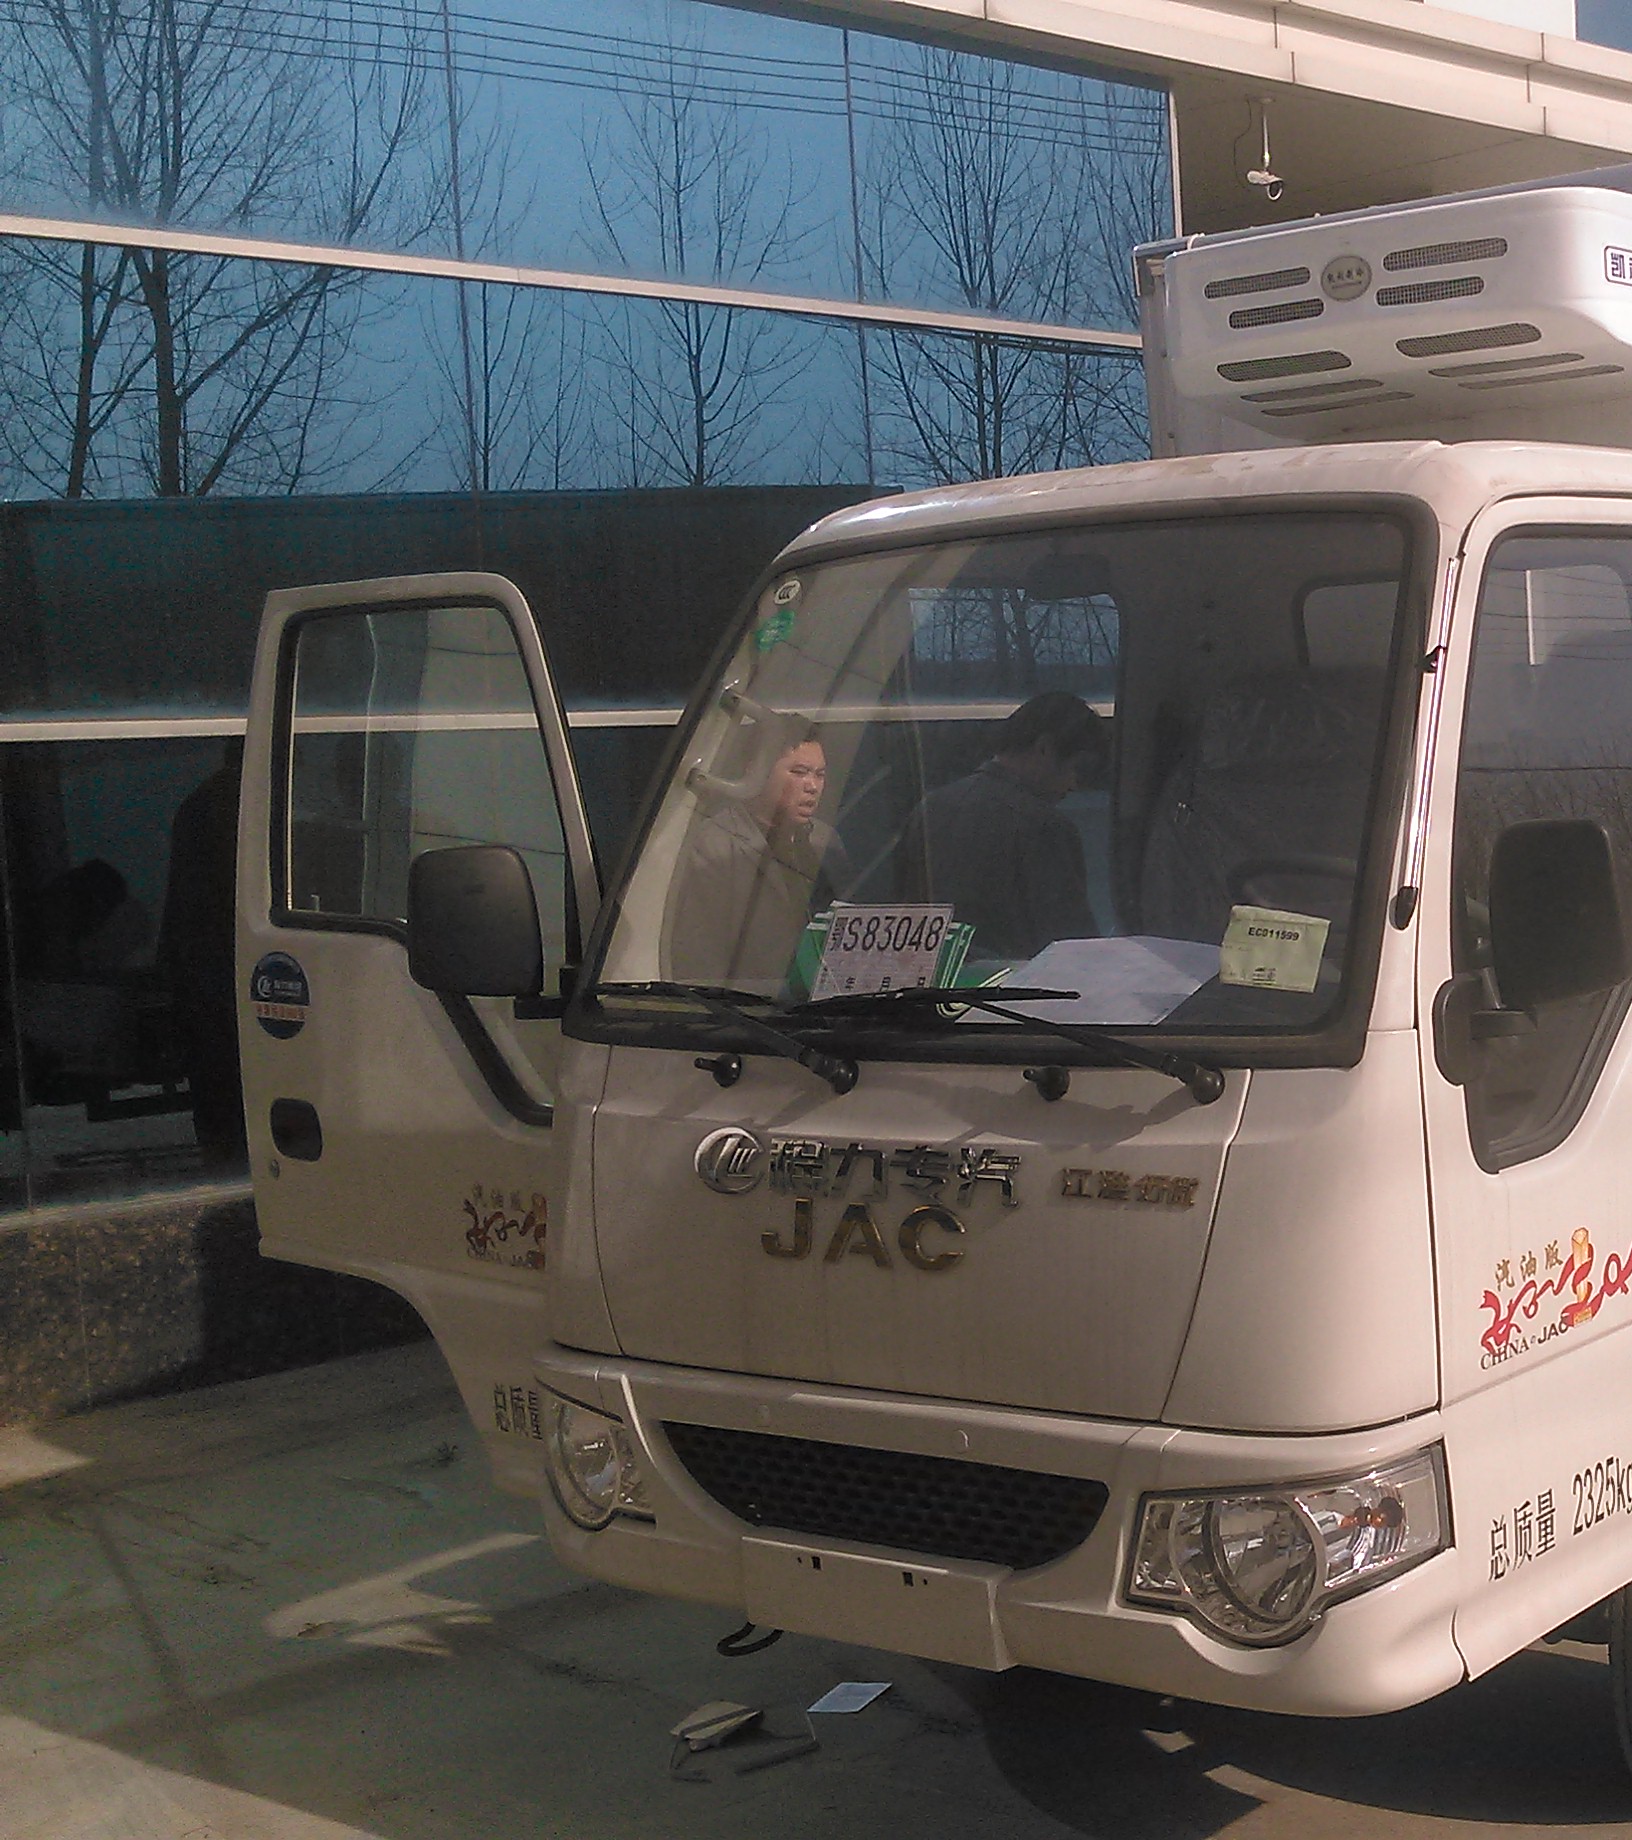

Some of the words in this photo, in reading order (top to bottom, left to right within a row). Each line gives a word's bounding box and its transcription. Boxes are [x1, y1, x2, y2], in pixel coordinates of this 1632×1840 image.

[768, 1137, 1022, 1209] 程力专汽
[760, 1196, 966, 1272] JAC
[1495, 1239, 1563, 1291] 汽油版
[1488, 1487, 1556, 1581] 总质量
